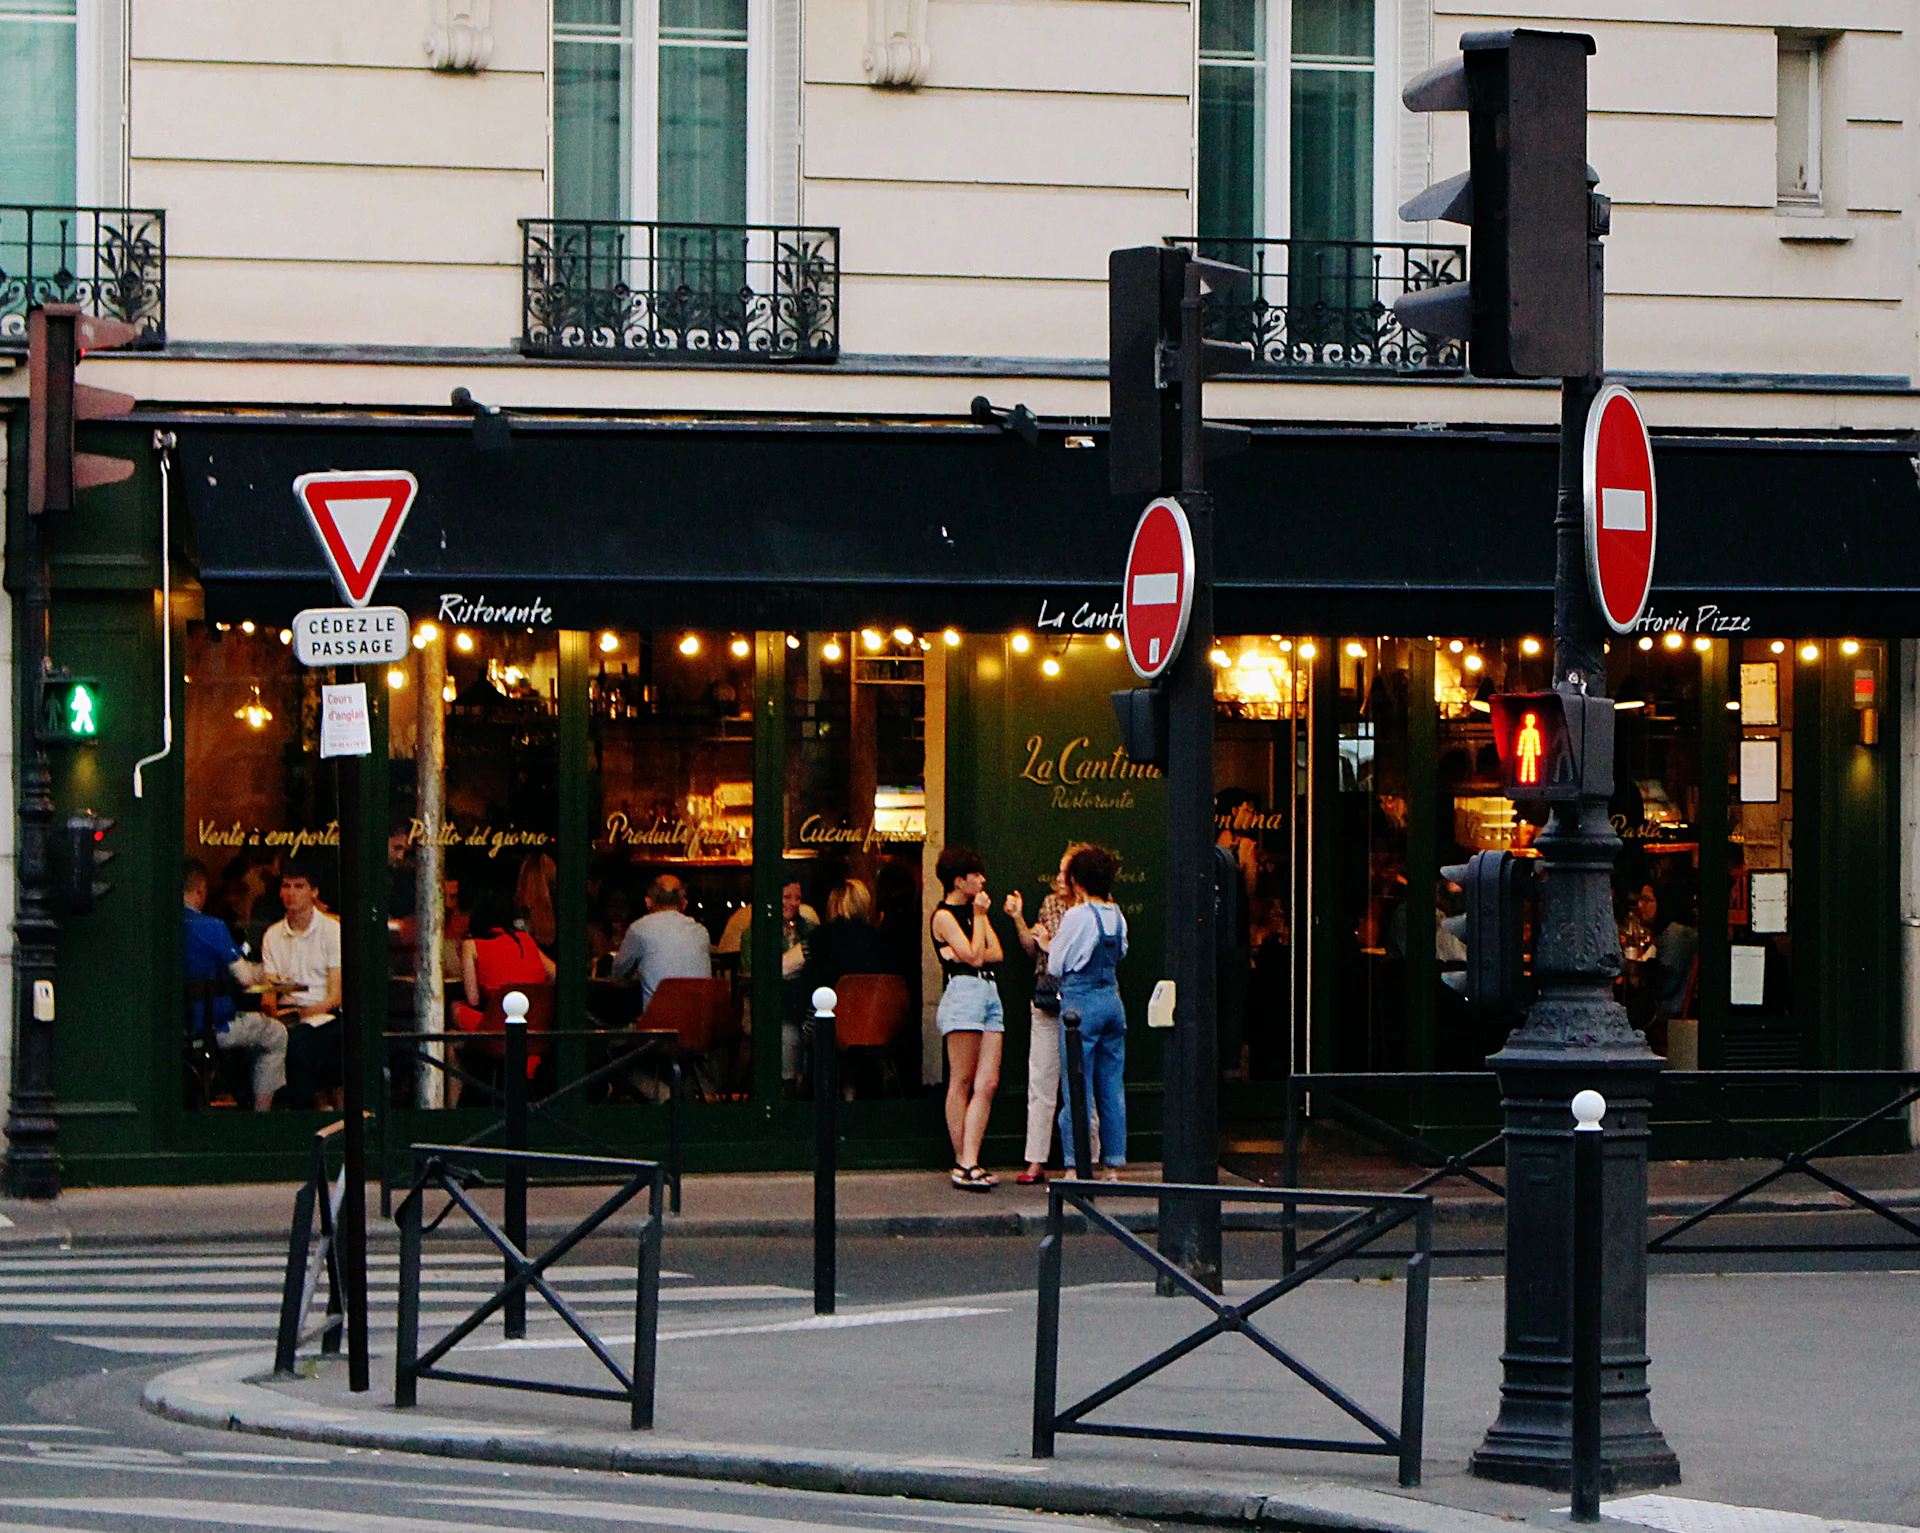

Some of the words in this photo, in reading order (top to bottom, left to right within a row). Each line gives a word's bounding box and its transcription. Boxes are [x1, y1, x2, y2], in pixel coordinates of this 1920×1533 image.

[438, 593, 553, 624] Ristorante
[1037, 599, 1065, 628] La
[1072, 602, 1124, 628] Canti
[1696, 605, 1751, 632] Pizze
[309, 616, 367, 634] CÉDEZ
[376, 617, 396, 632] LE
[312, 639, 393, 656] PASSAGE
[327, 693, 353, 705] Cours
[1019, 735, 1055, 785] La
[1058, 737, 1162, 785] Cantina
[1051, 785, 1135, 809] Ristorante
[198, 818, 246, 847] Vente
[248, 827, 260, 846] à
[264, 819, 340, 859] emporte
[800, 814, 863, 843] Cucina
[1610, 813, 1663, 839] Pasta
[465, 825, 491, 846] del
[488, 822, 549, 859] giorno
